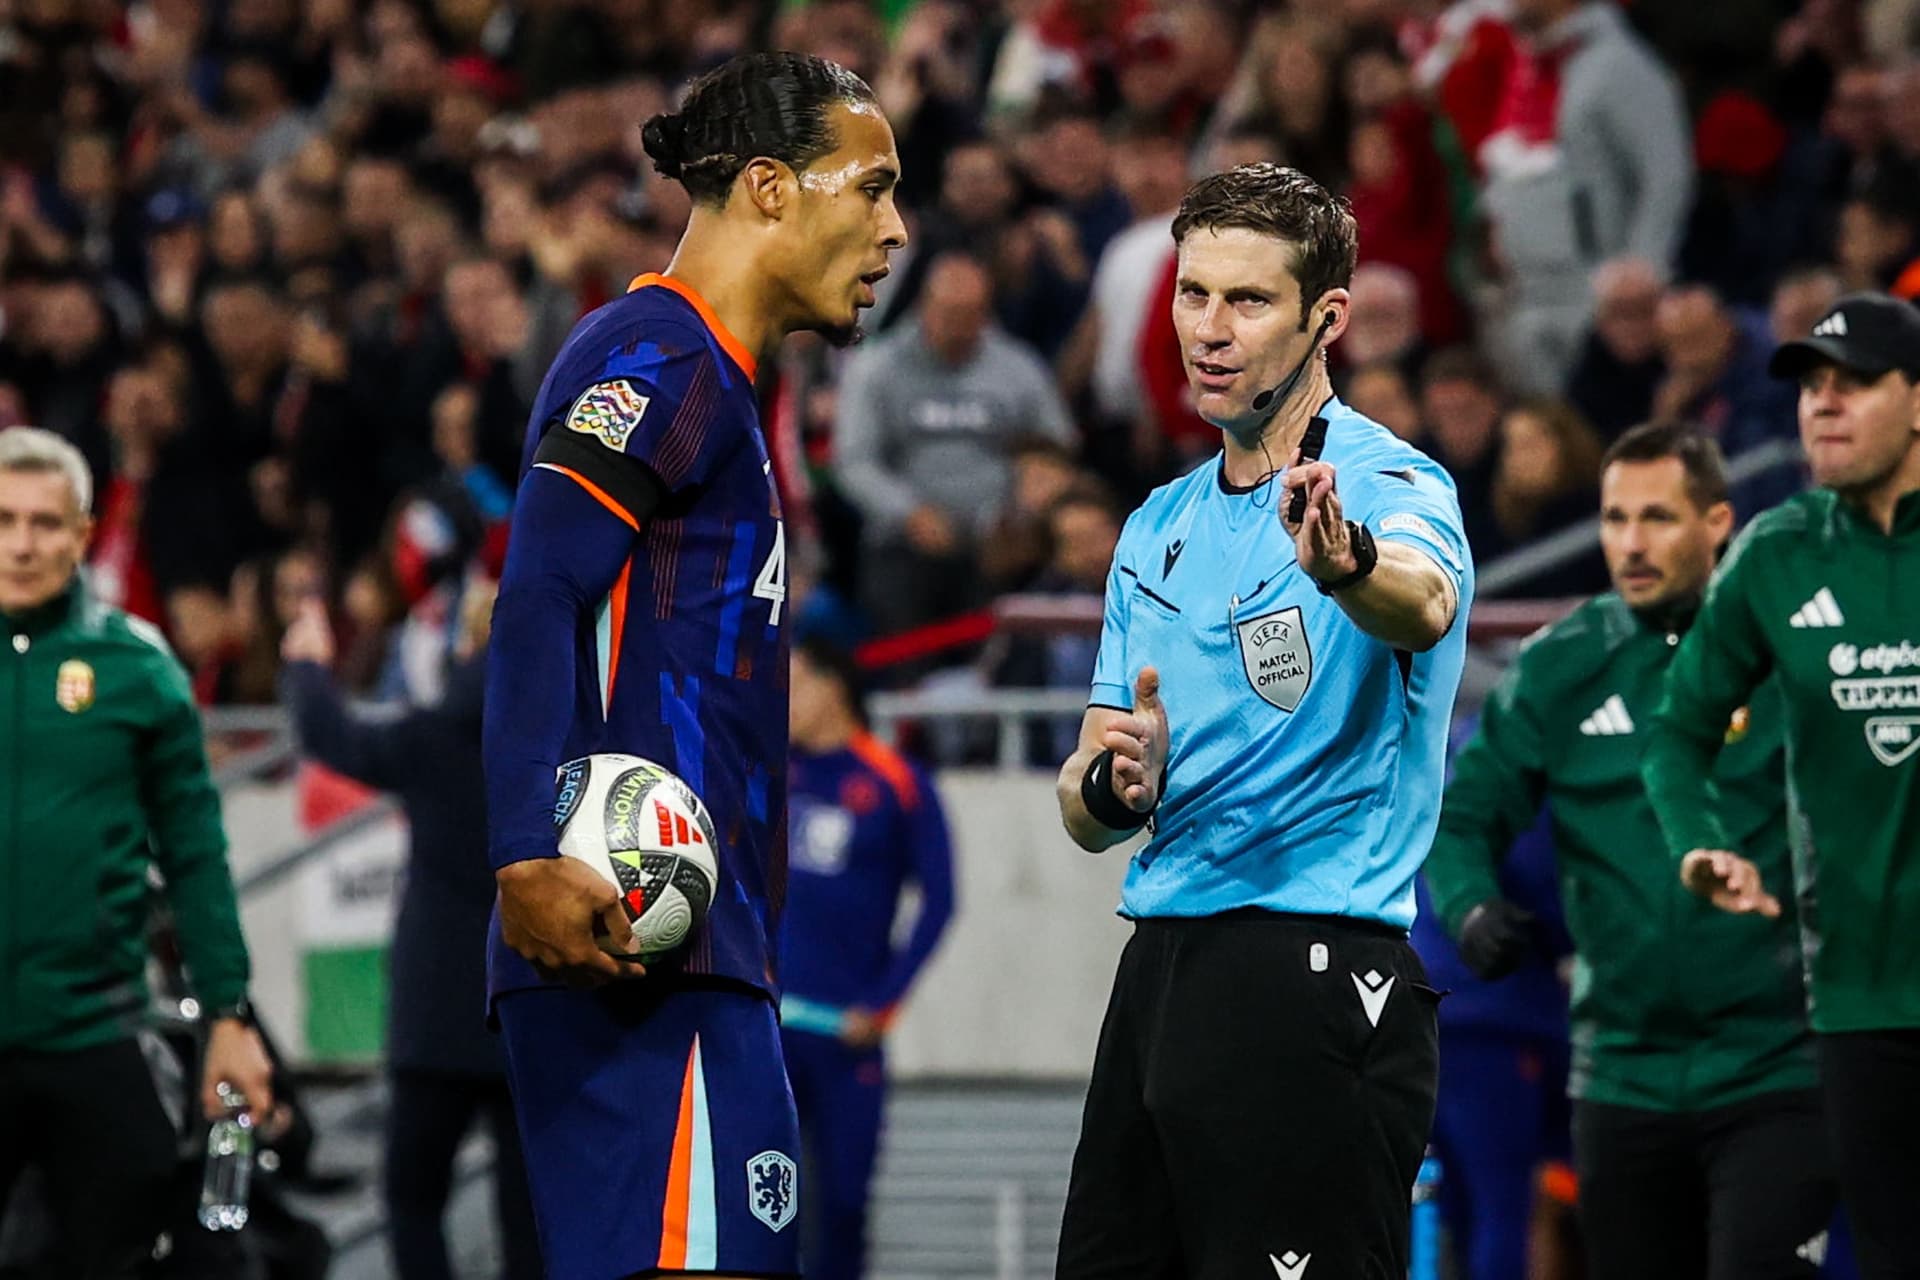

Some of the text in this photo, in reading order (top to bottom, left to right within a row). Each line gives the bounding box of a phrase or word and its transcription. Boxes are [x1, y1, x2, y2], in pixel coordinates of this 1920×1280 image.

[752, 520, 786, 626] 4
[1253, 625, 1288, 646] UEFA
[1259, 652, 1296, 670] MATCH
[1257, 666, 1304, 686] OFFICIAL
[614, 770, 648, 841] NATIONS
